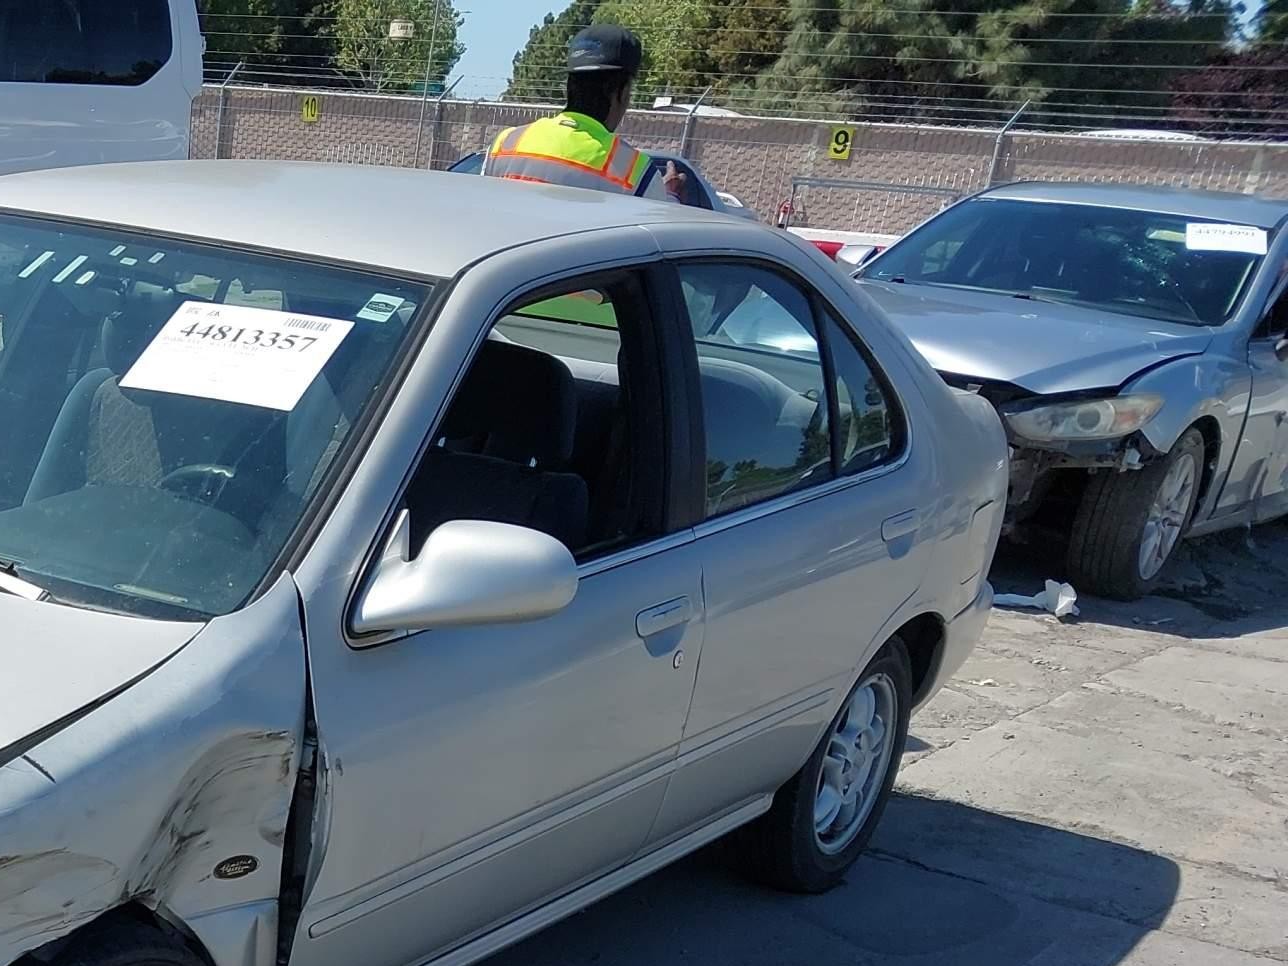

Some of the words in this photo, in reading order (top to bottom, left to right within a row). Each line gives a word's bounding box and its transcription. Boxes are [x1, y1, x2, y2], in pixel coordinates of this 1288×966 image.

[305, 97, 317, 118] 10
[833, 130, 850, 154] 9
[180, 322, 318, 352] 44813357
